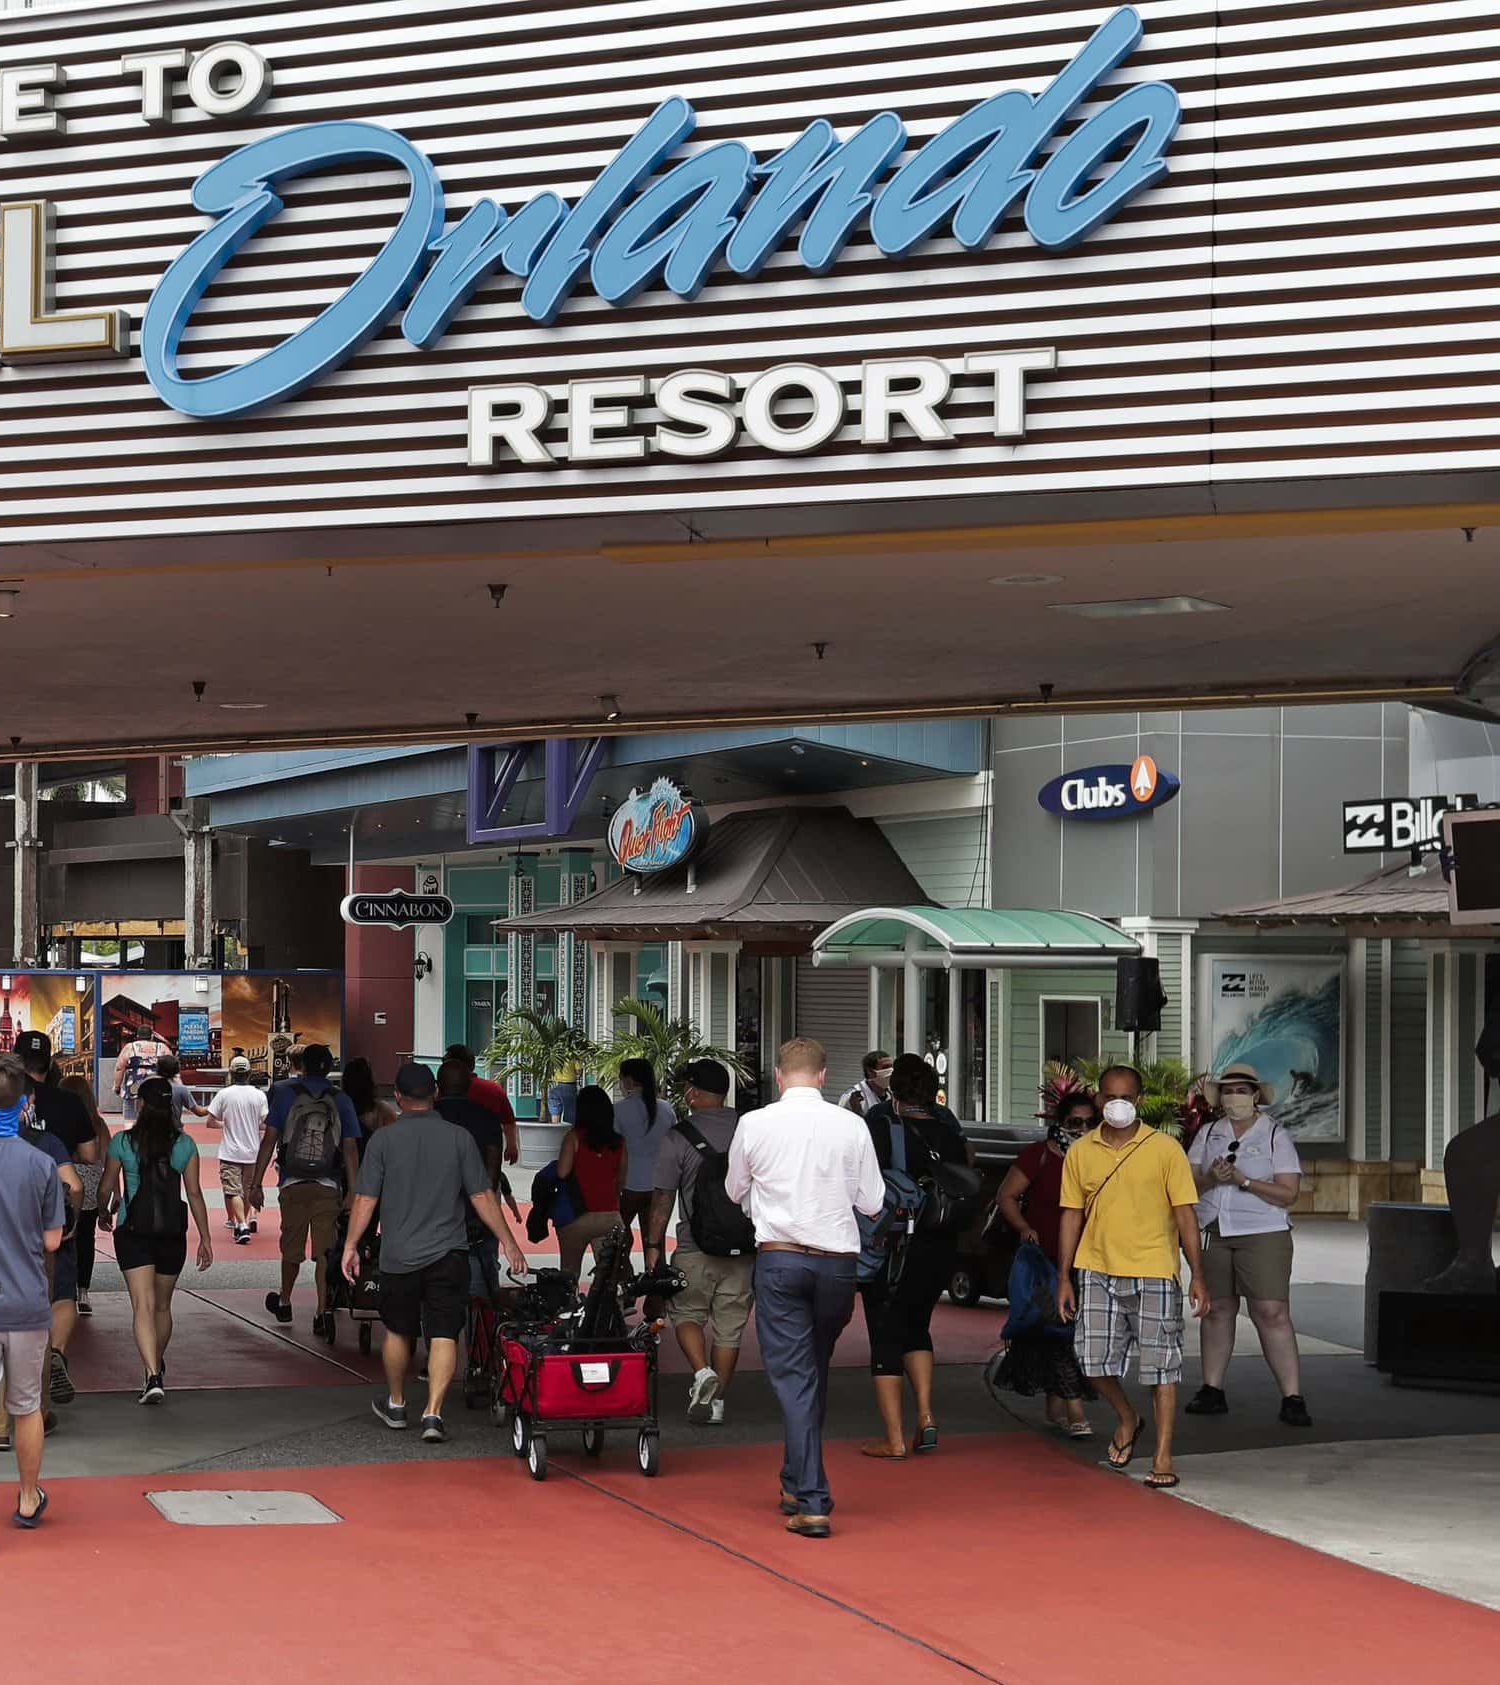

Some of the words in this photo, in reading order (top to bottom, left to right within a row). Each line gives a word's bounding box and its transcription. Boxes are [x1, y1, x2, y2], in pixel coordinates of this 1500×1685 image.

[121, 41, 273, 125] TO
[141, 4, 1181, 419] Orlando
[467, 347, 1057, 468] RESORT
[649, 799, 692, 857] Flight
[1060, 776, 1126, 811] Clubs
[355, 900, 445, 917] CINNABON
